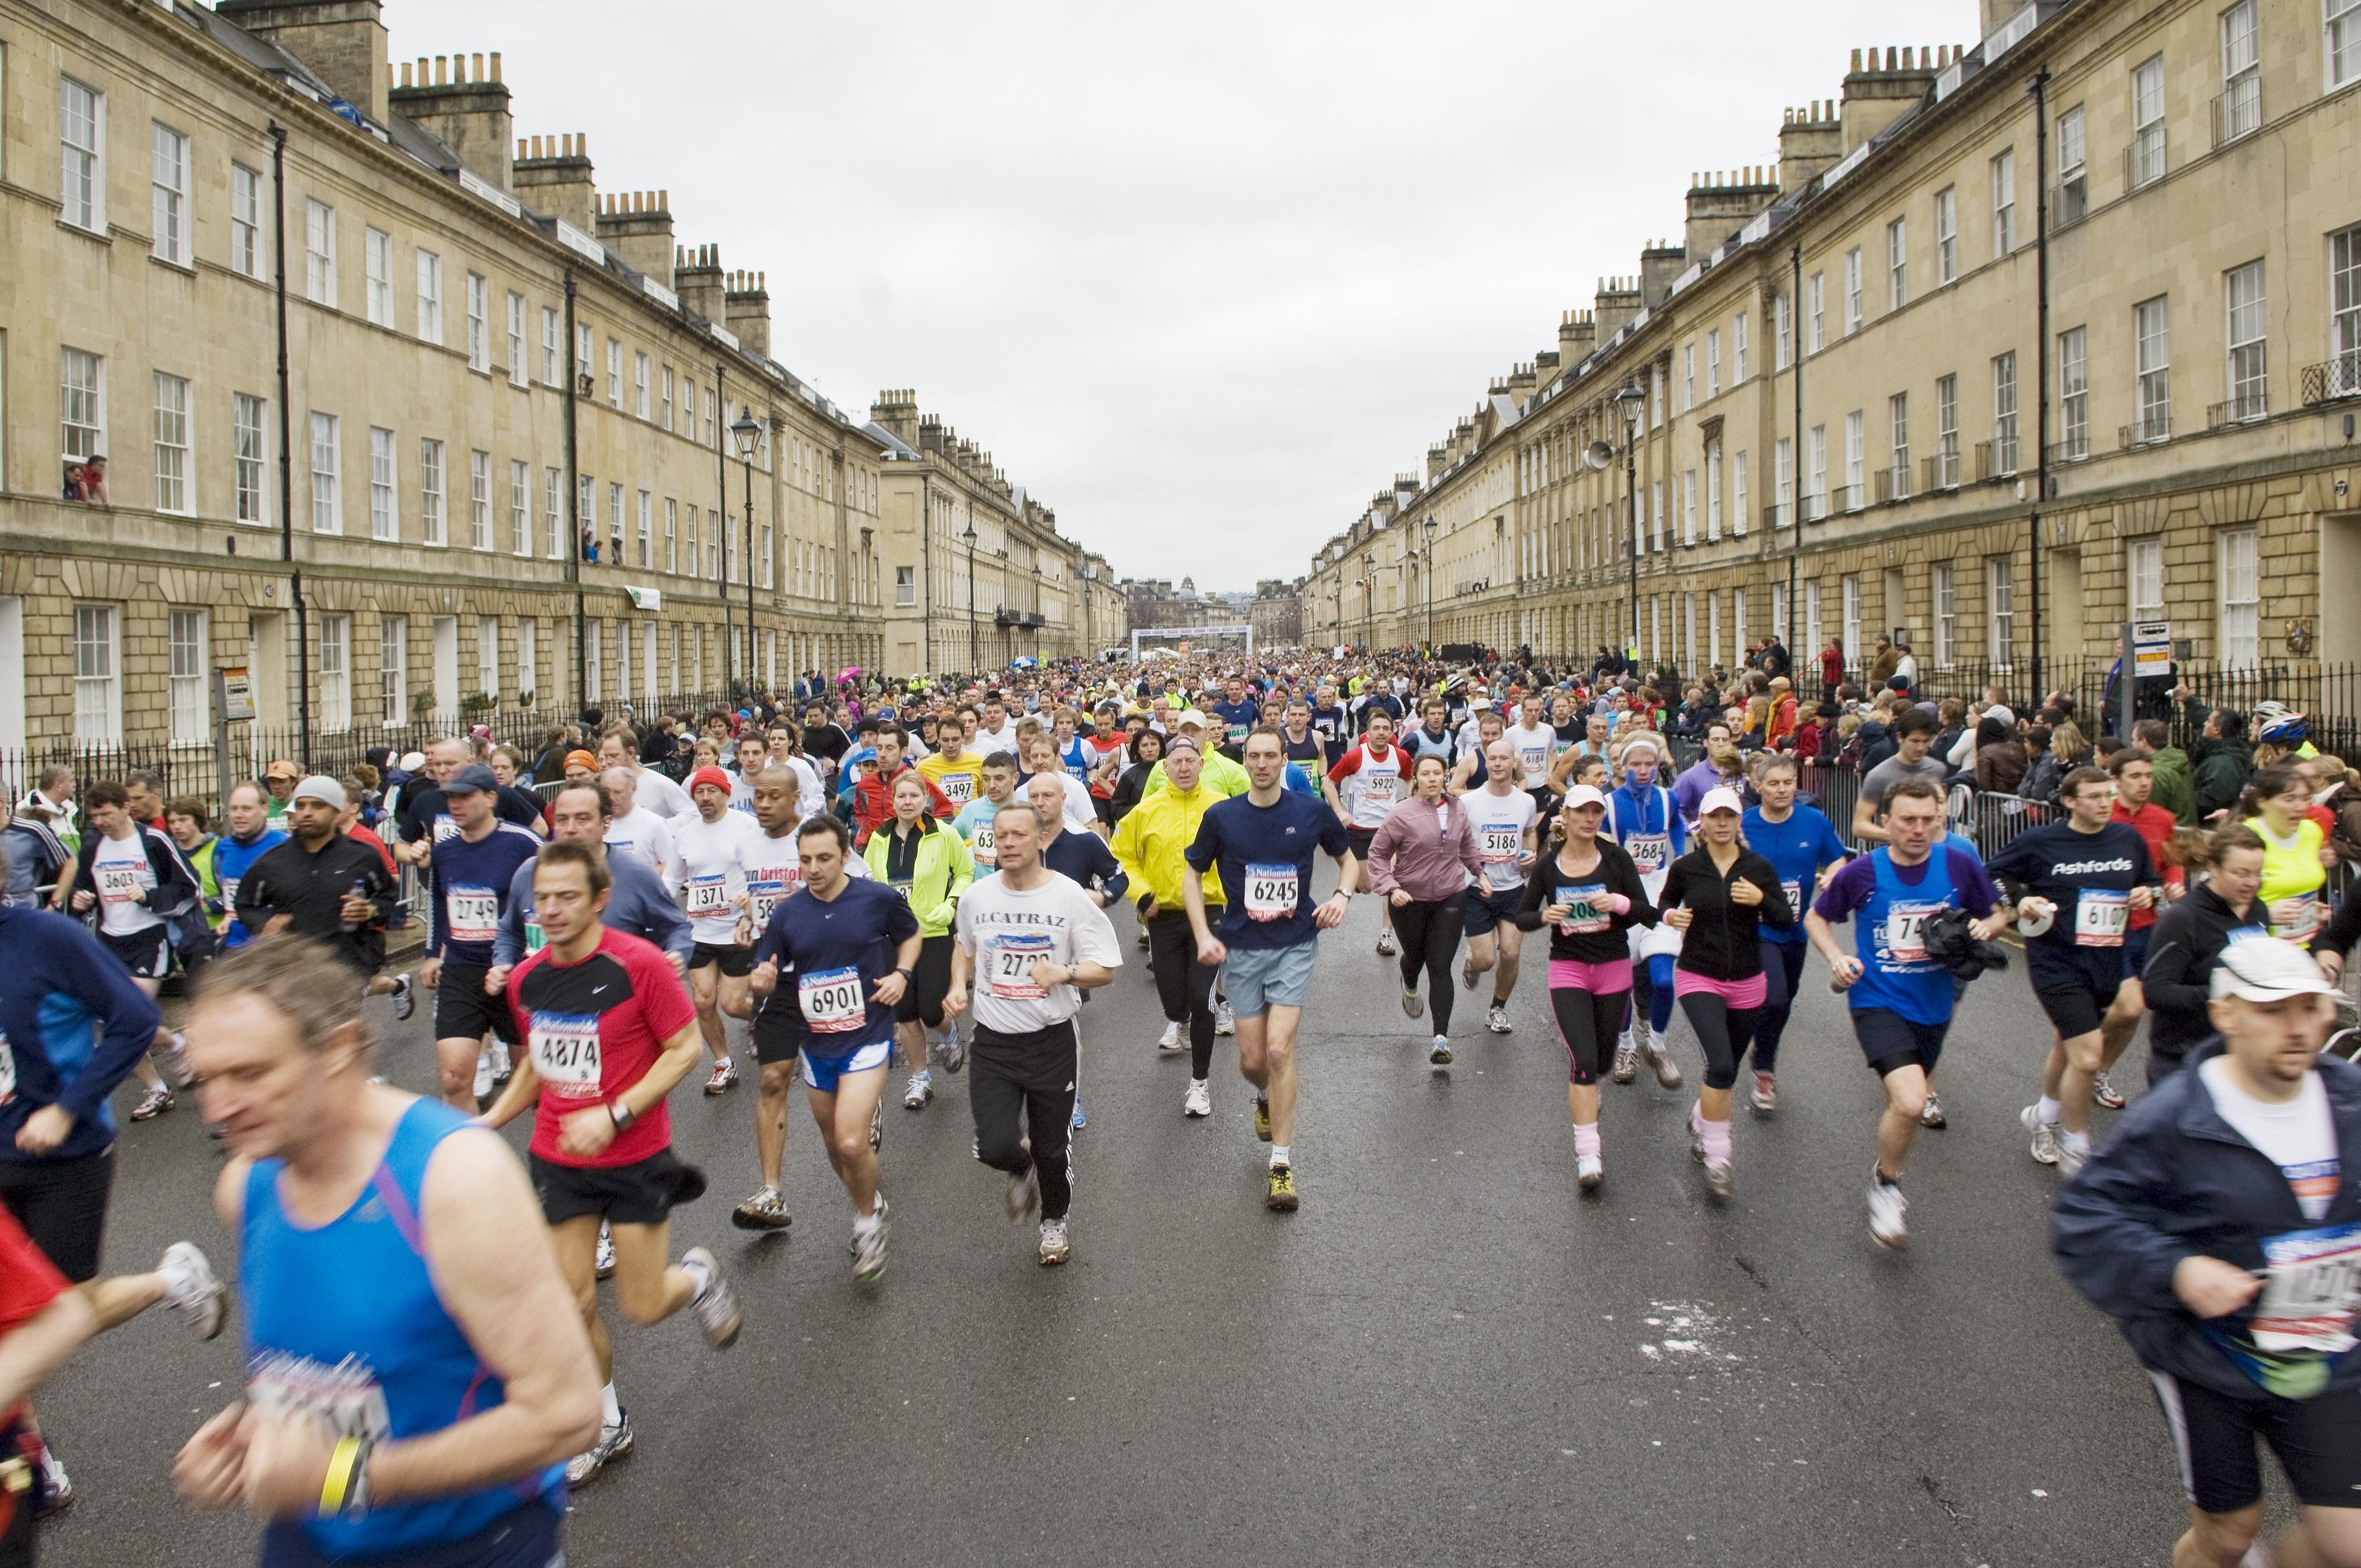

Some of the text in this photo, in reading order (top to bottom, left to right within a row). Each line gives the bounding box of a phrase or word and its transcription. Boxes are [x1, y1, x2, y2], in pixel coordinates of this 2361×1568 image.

[1229, 728, 1247, 737] 10447
[946, 782, 972, 797] 3497
[1372, 778, 1394, 789] 5922
[1487, 834, 1515, 849] 5186
[1633, 842, 1665, 859] 3684
[1256, 867, 1297, 878] Nationwide
[2051, 858, 2132, 876] Ashfords
[105, 872, 134, 888] 3603
[696, 887, 724, 906] 1371
[1254, 881, 1297, 901] 6245
[456, 900, 495, 920] 2749
[813, 984, 858, 1014] 6901
[542, 1038, 598, 1068] 4874
